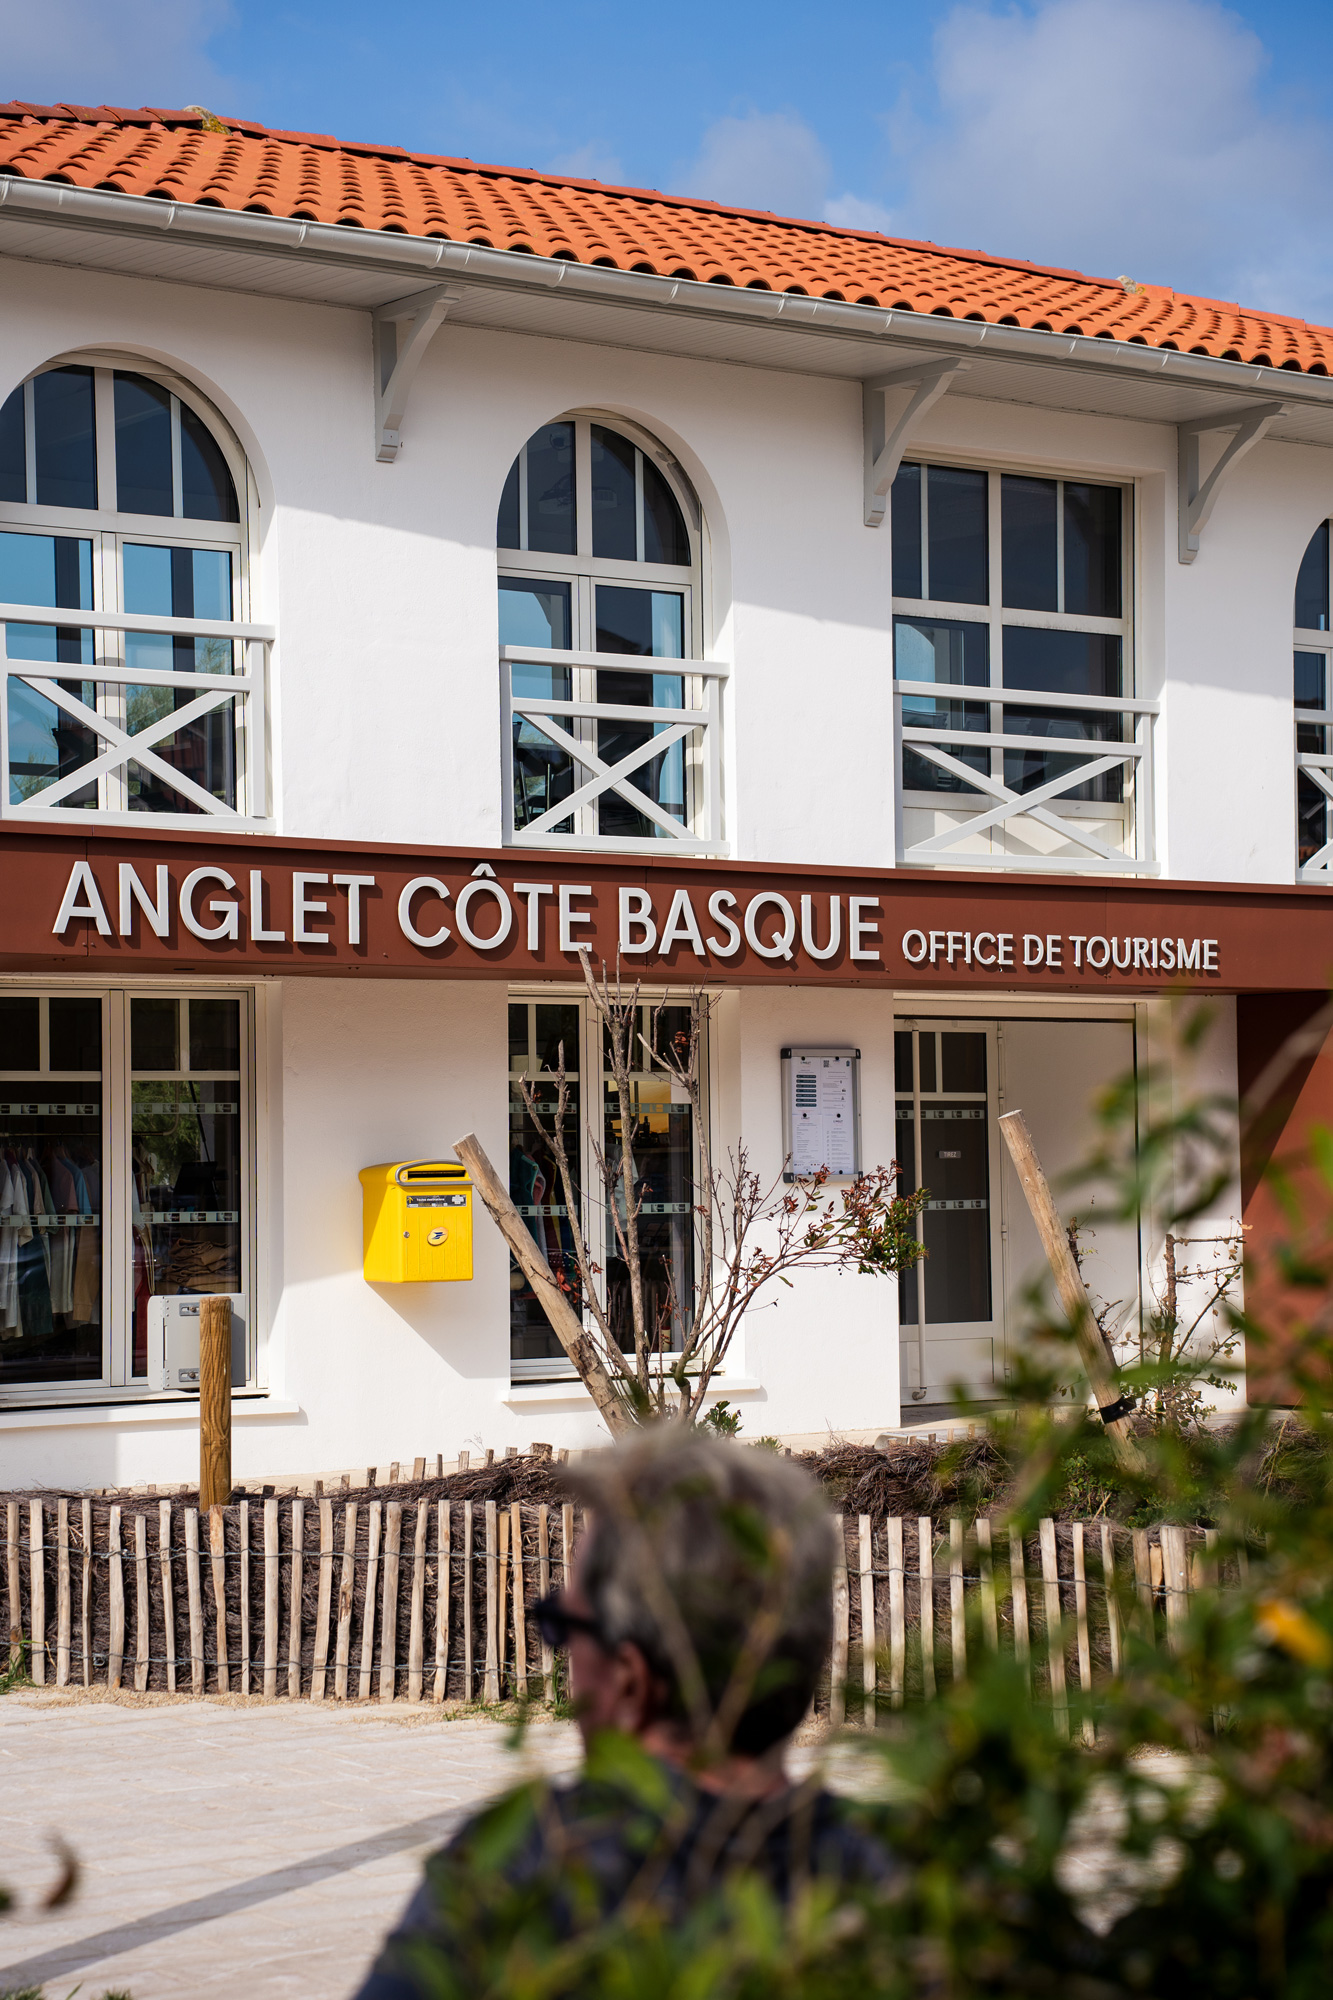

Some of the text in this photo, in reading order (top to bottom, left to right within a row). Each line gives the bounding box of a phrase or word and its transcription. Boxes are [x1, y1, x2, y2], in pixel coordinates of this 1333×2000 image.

[52, 861, 880, 961] ANGLET CÔTE BASQUE
[902, 929, 1218, 970] OFFICE DE TOURISME
